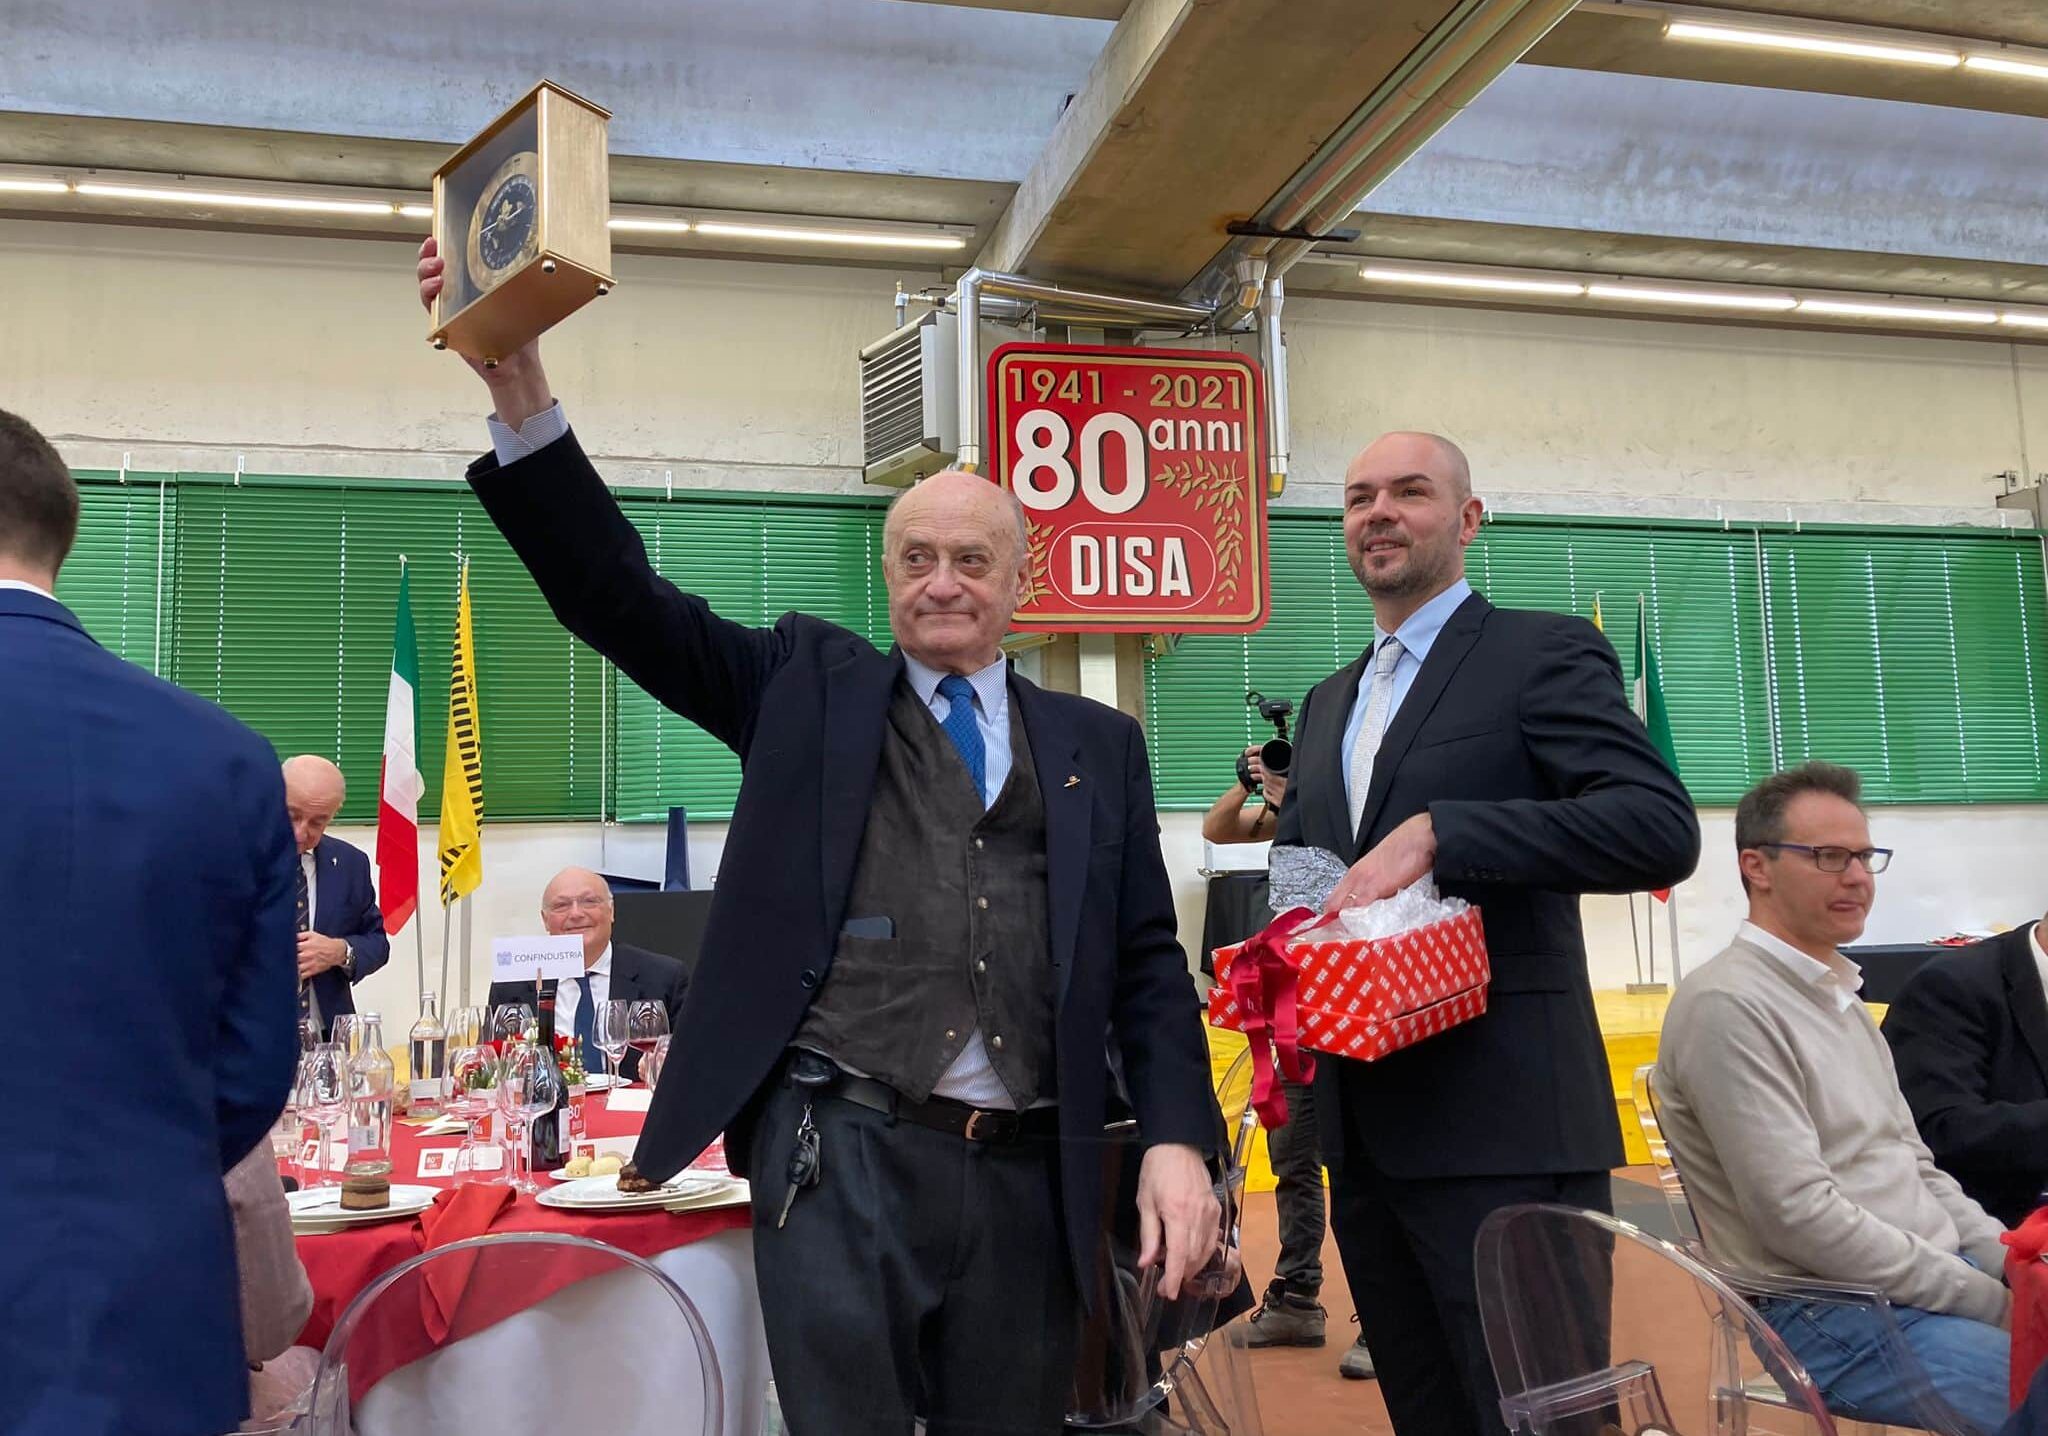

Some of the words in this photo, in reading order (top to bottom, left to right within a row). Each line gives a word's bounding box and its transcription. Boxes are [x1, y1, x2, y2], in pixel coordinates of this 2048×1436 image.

[1009, 368, 1102, 404] 1941
[1150, 373, 1241, 410] 2021
[1012, 408, 1146, 514] 80
[1149, 418, 1241, 452] anni
[1070, 535, 1192, 597] DISA
[514, 951, 583, 963] CONFINDUSTRIA
